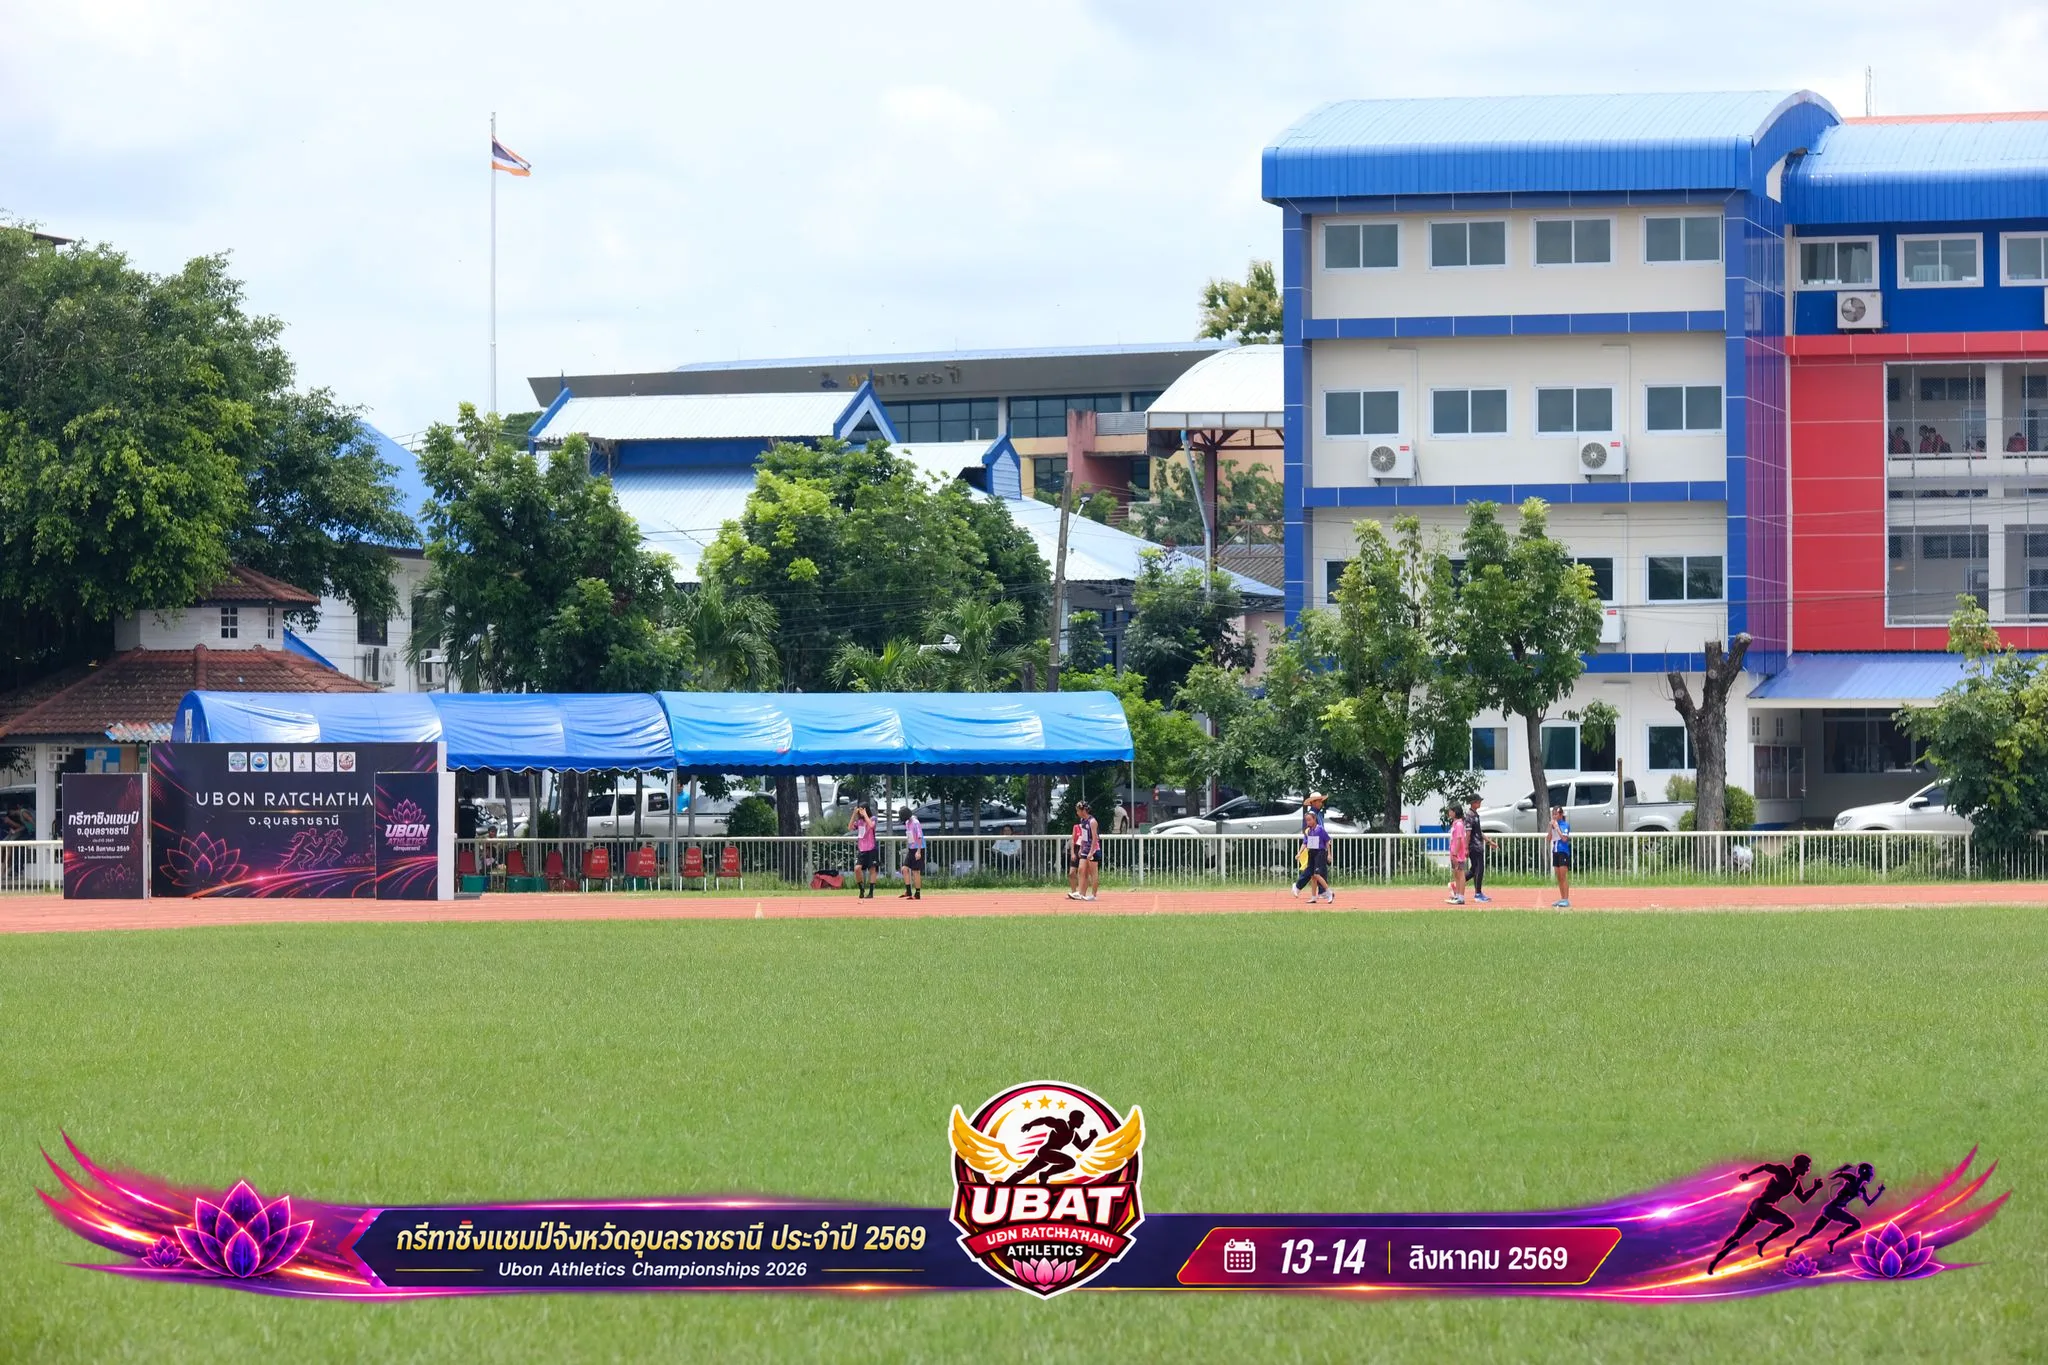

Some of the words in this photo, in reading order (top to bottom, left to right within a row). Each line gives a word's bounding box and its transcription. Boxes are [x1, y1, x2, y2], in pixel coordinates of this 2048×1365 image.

[195, 791, 255, 807] UBON
[264, 791, 374, 807] RATCHATHA
[248, 813, 339, 829] จ.อุบลราชธานี
[385, 824, 431, 838] UBON
